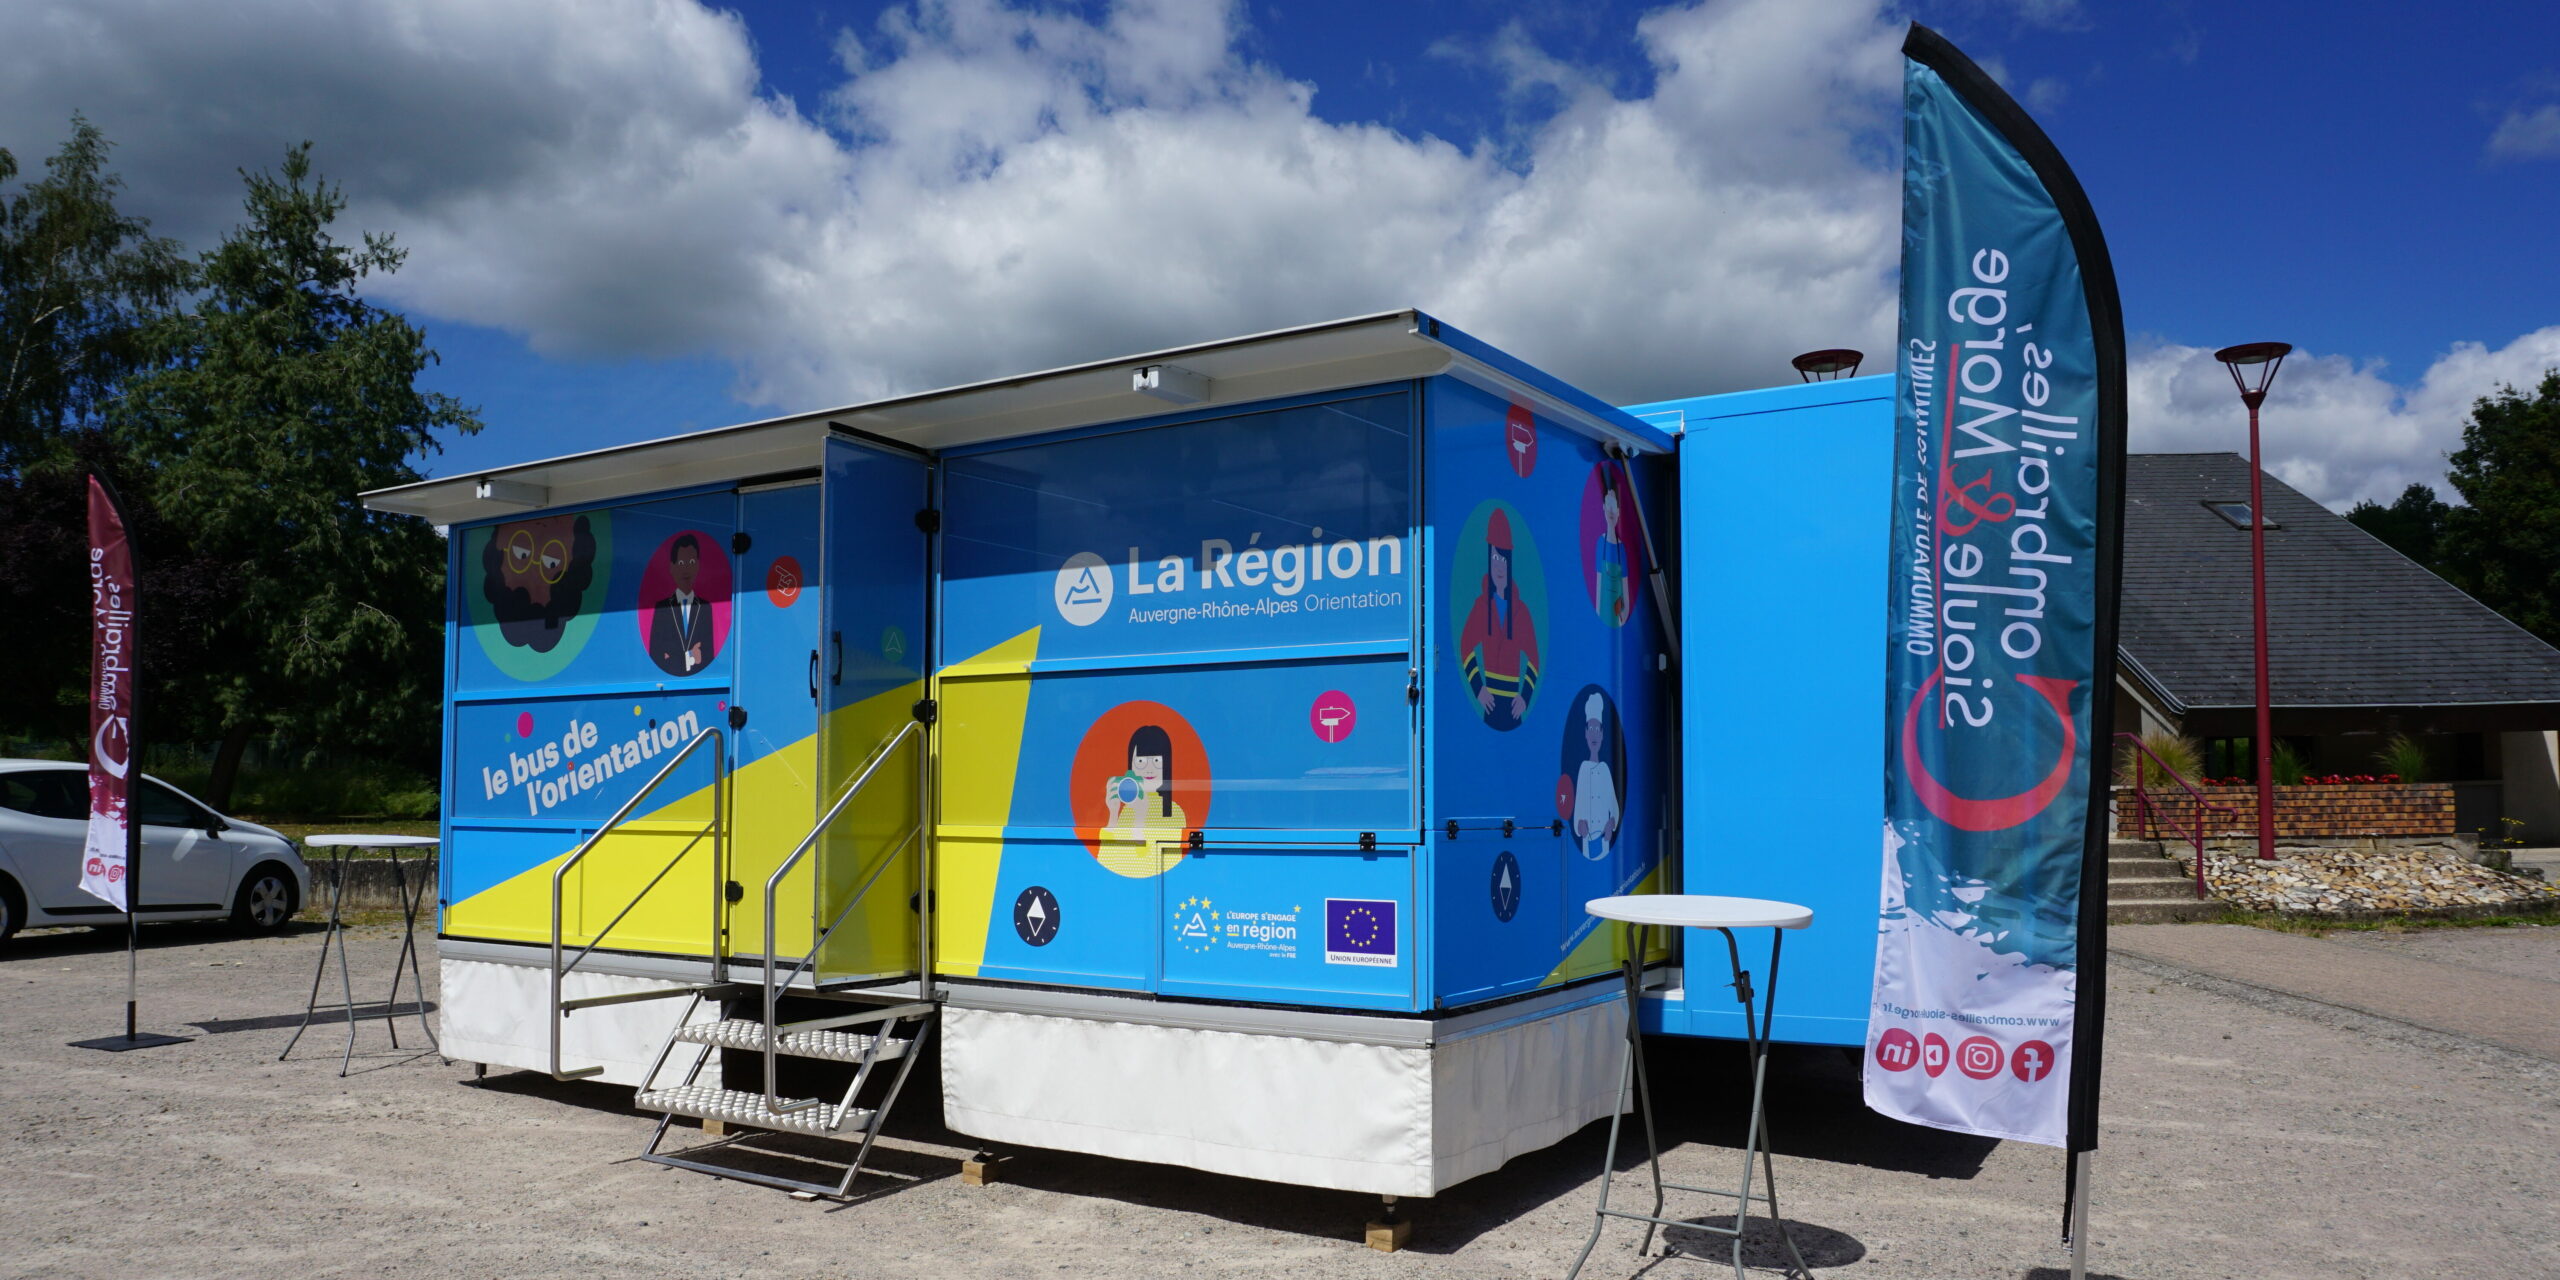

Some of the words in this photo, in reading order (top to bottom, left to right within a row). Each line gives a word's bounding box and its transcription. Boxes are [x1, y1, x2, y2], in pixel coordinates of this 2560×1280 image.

[1128, 546, 1185, 595] La
[1201, 526, 1402, 596] Région
[1128, 596, 1298, 624] Auvergne-Rhône-Alpes
[1304, 590, 1402, 612] Orientation
[482, 766, 509, 800] le
[509, 738, 559, 787] bus
[563, 719, 599, 760] de
[526, 709, 701, 816] l'orientation
[1226, 910, 1259, 921] L'EUROPE
[1261, 911, 1297, 922] S'ENGAGE
[1226, 924, 1240, 933] en
[1243, 920, 1297, 942] région
[1330, 954, 1352, 963] UNION
